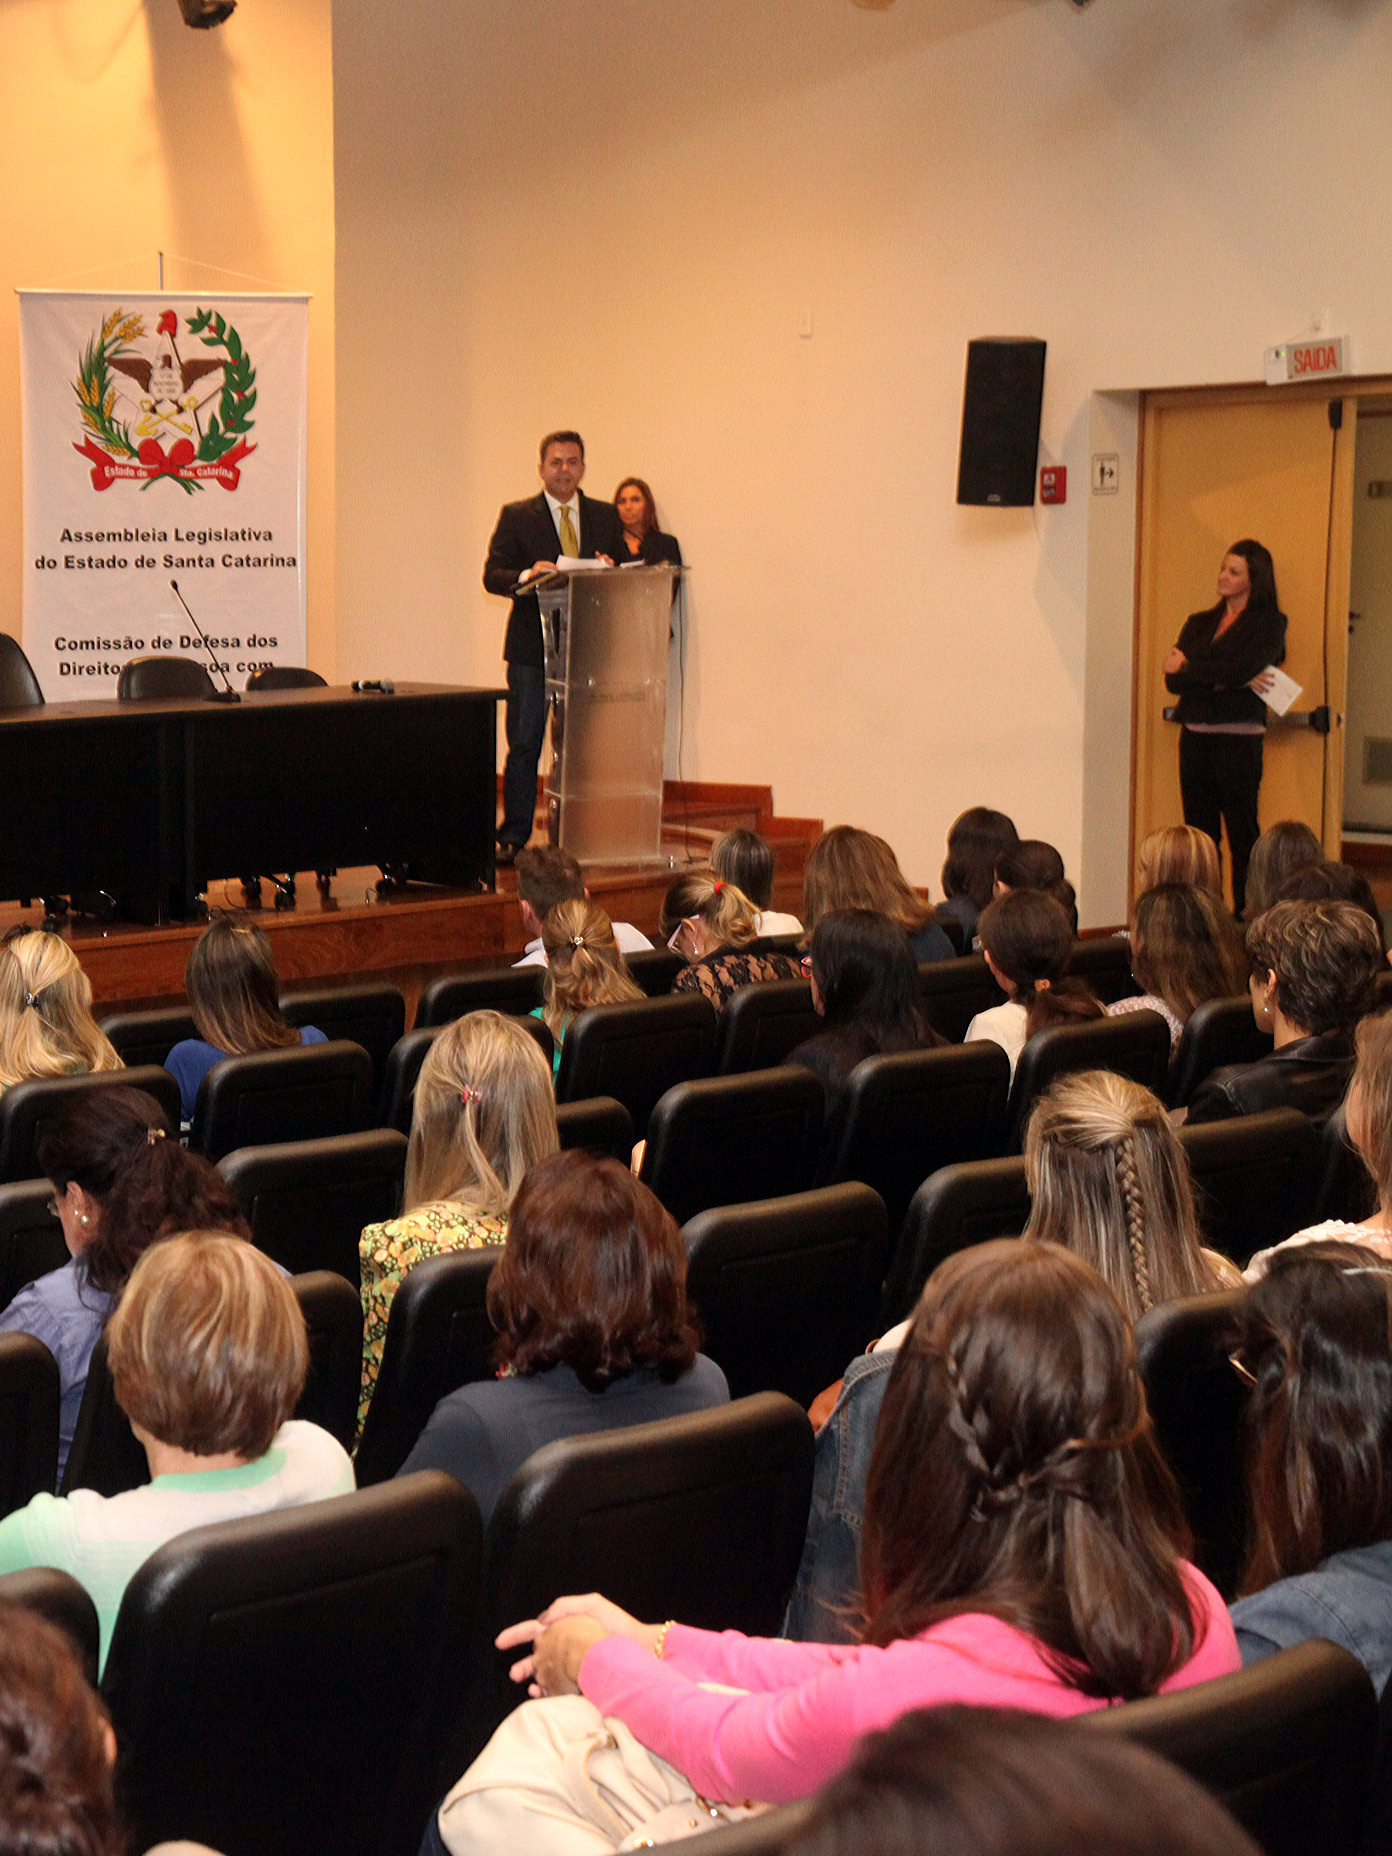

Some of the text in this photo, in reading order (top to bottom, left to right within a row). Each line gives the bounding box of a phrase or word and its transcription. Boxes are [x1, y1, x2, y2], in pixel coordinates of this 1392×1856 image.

[104, 464, 135, 478] Estado
[196, 467, 234, 480] Catarina
[60, 528, 273, 545] Assembleia Legislativa
[35, 553, 297, 569] do Estado de Santa Catarina
[54, 633, 278, 651] Comissão de Defesa dos
[59, 661, 127, 676] Direito
